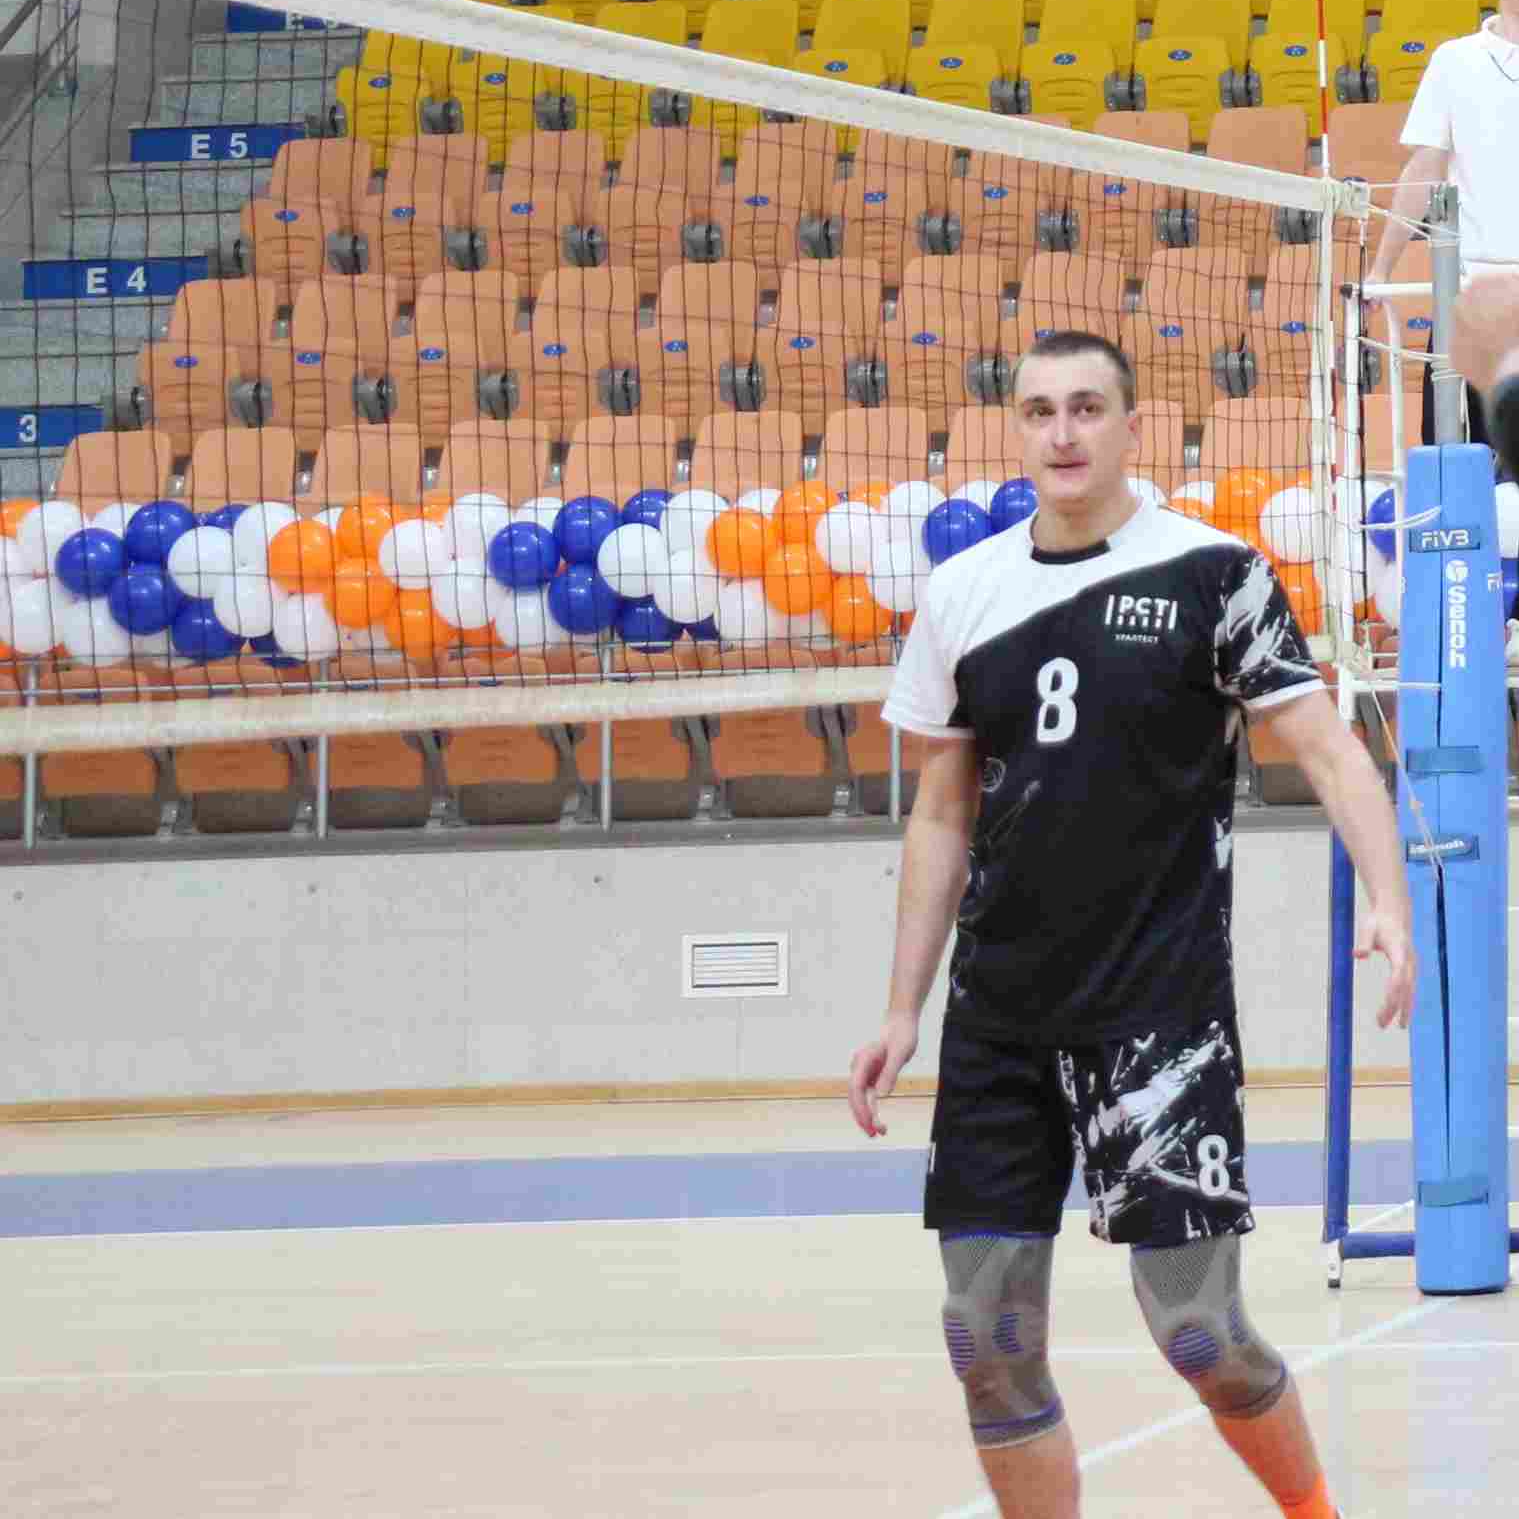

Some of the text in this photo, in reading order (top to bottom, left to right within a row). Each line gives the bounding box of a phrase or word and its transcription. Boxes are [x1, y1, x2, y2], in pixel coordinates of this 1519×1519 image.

[191, 133, 249, 159] E 5
[86, 265, 147, 294] E 4
[18, 414, 38, 443] 3
[1037, 657, 1079, 743] 8
[1197, 1133, 1230, 1197] 8
